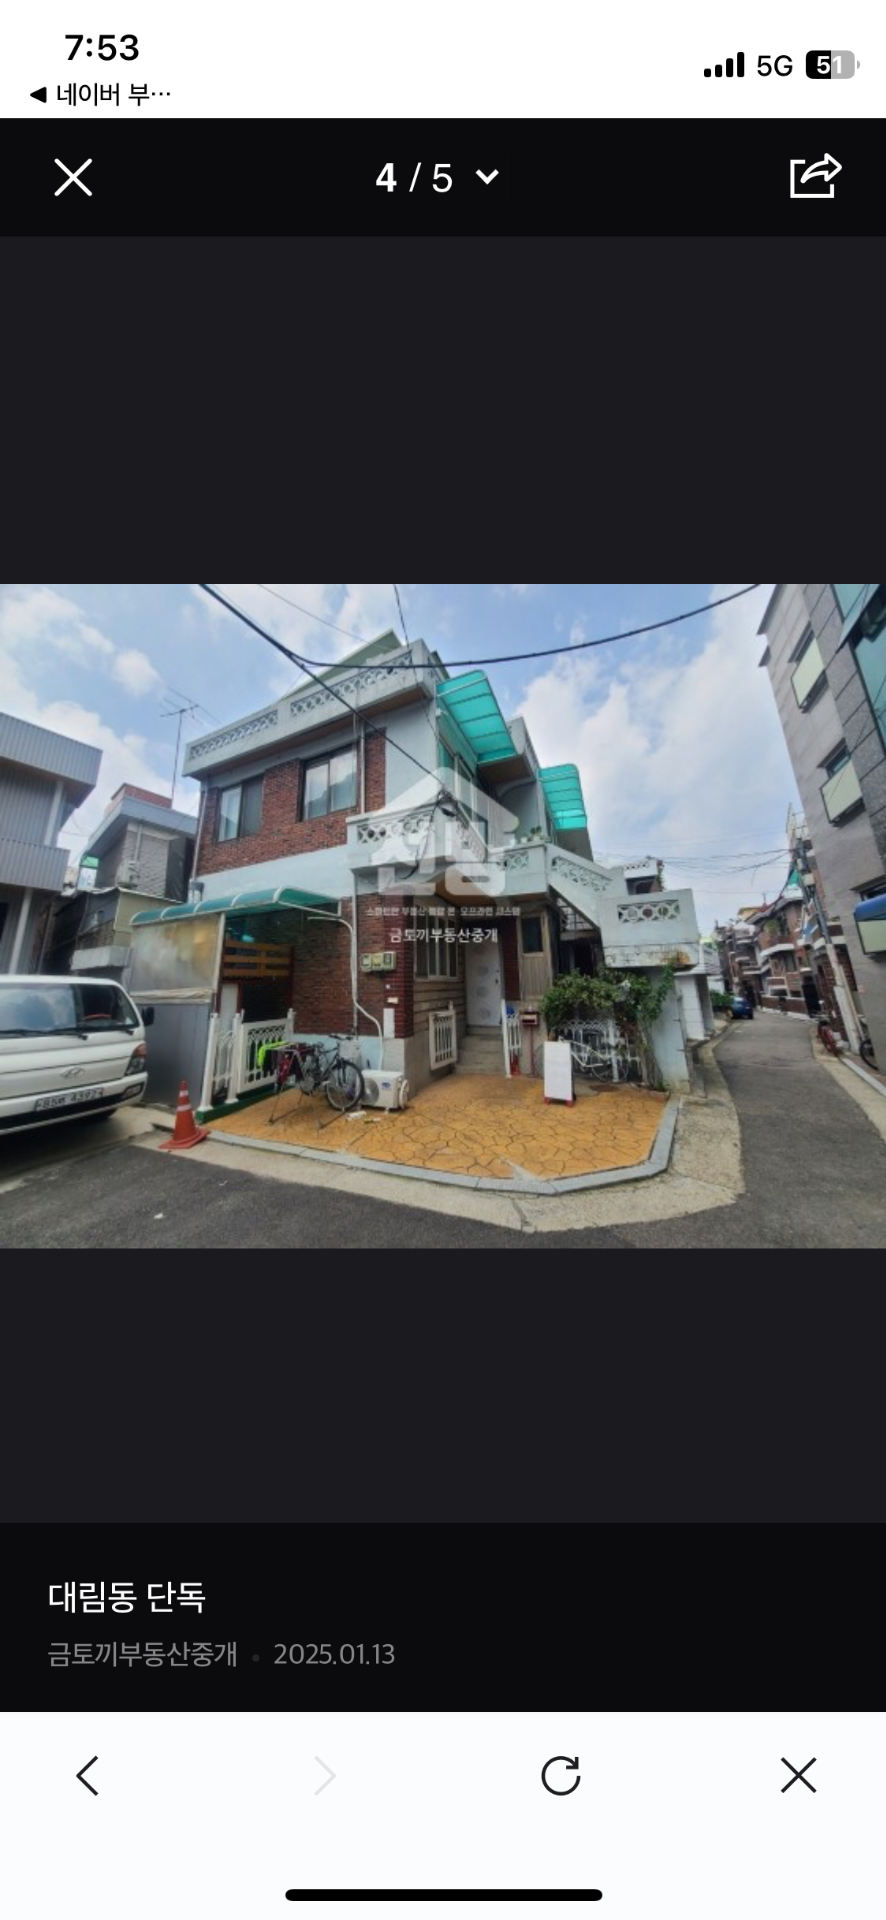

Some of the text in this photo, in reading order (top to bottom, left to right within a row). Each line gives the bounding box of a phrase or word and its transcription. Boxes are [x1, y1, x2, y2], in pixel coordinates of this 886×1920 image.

[64, 33, 140, 62] 7:53
[757, 54, 793, 77] 5G
[816, 55, 842, 74] 51
[56, 82, 120, 107] 네이버
[375, 161, 453, 193] 4 / 5
[48, 1581, 206, 1614] 대림동 단독
[47, 1641, 238, 1668] 금토끼부동산중개
[273, 1643, 395, 1665] 2025.01.13
